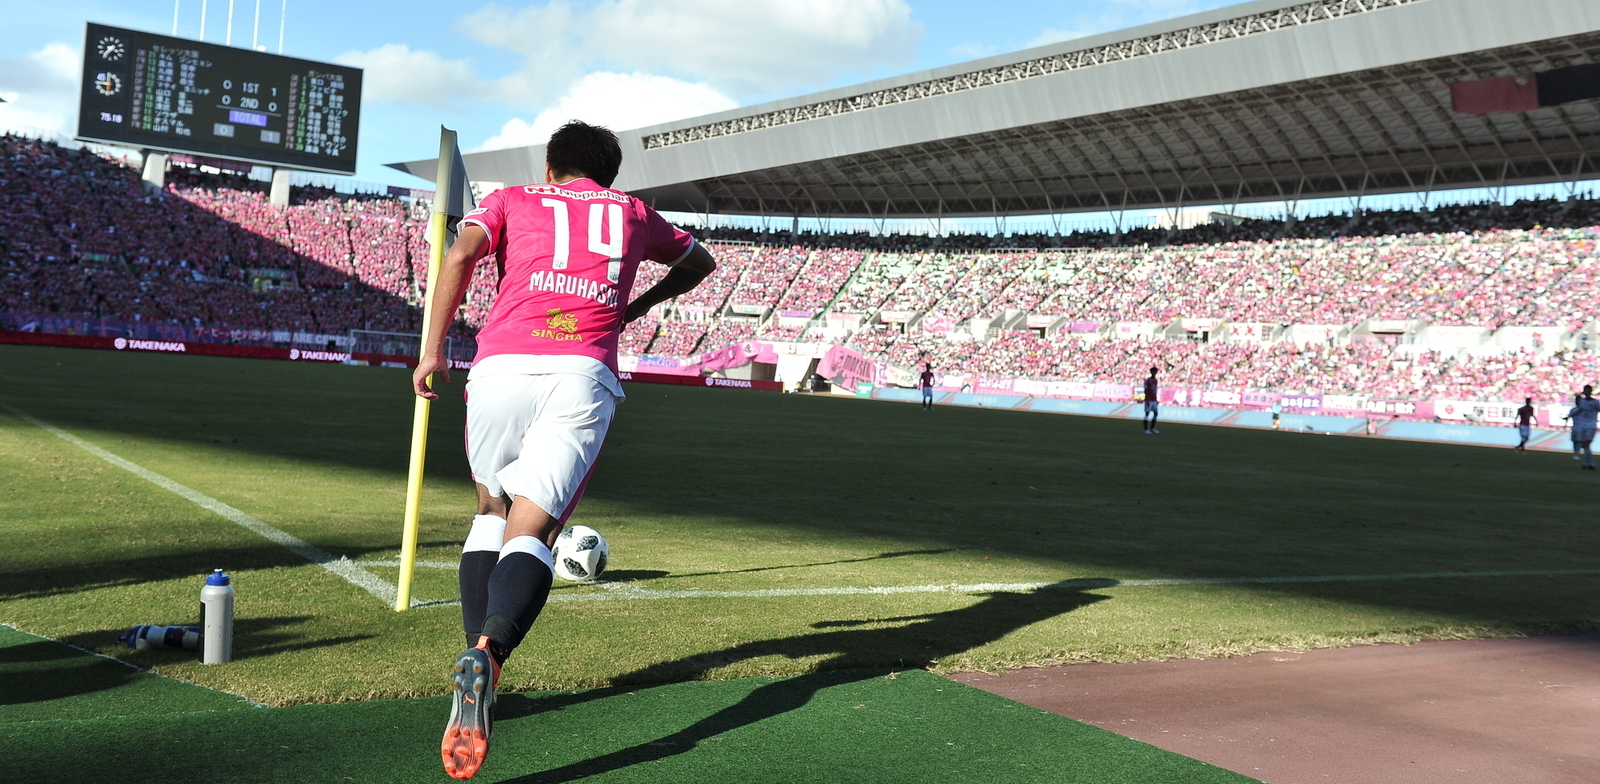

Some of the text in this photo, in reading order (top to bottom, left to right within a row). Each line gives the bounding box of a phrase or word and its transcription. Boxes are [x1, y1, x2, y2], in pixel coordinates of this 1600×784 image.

[222, 79, 277, 97] 0 1ST 1
[221, 94, 278, 113] 0 2ND 0
[235, 111, 261, 125] TOTAL
[541, 198, 623, 284] 14
[272, 331, 291, 342] WE
[293, 333, 314, 344] ARE
[530, 329, 584, 342] SINGHA
[128, 339, 186, 353] TAKENAKA
[714, 378, 752, 389] TAKENAKA
